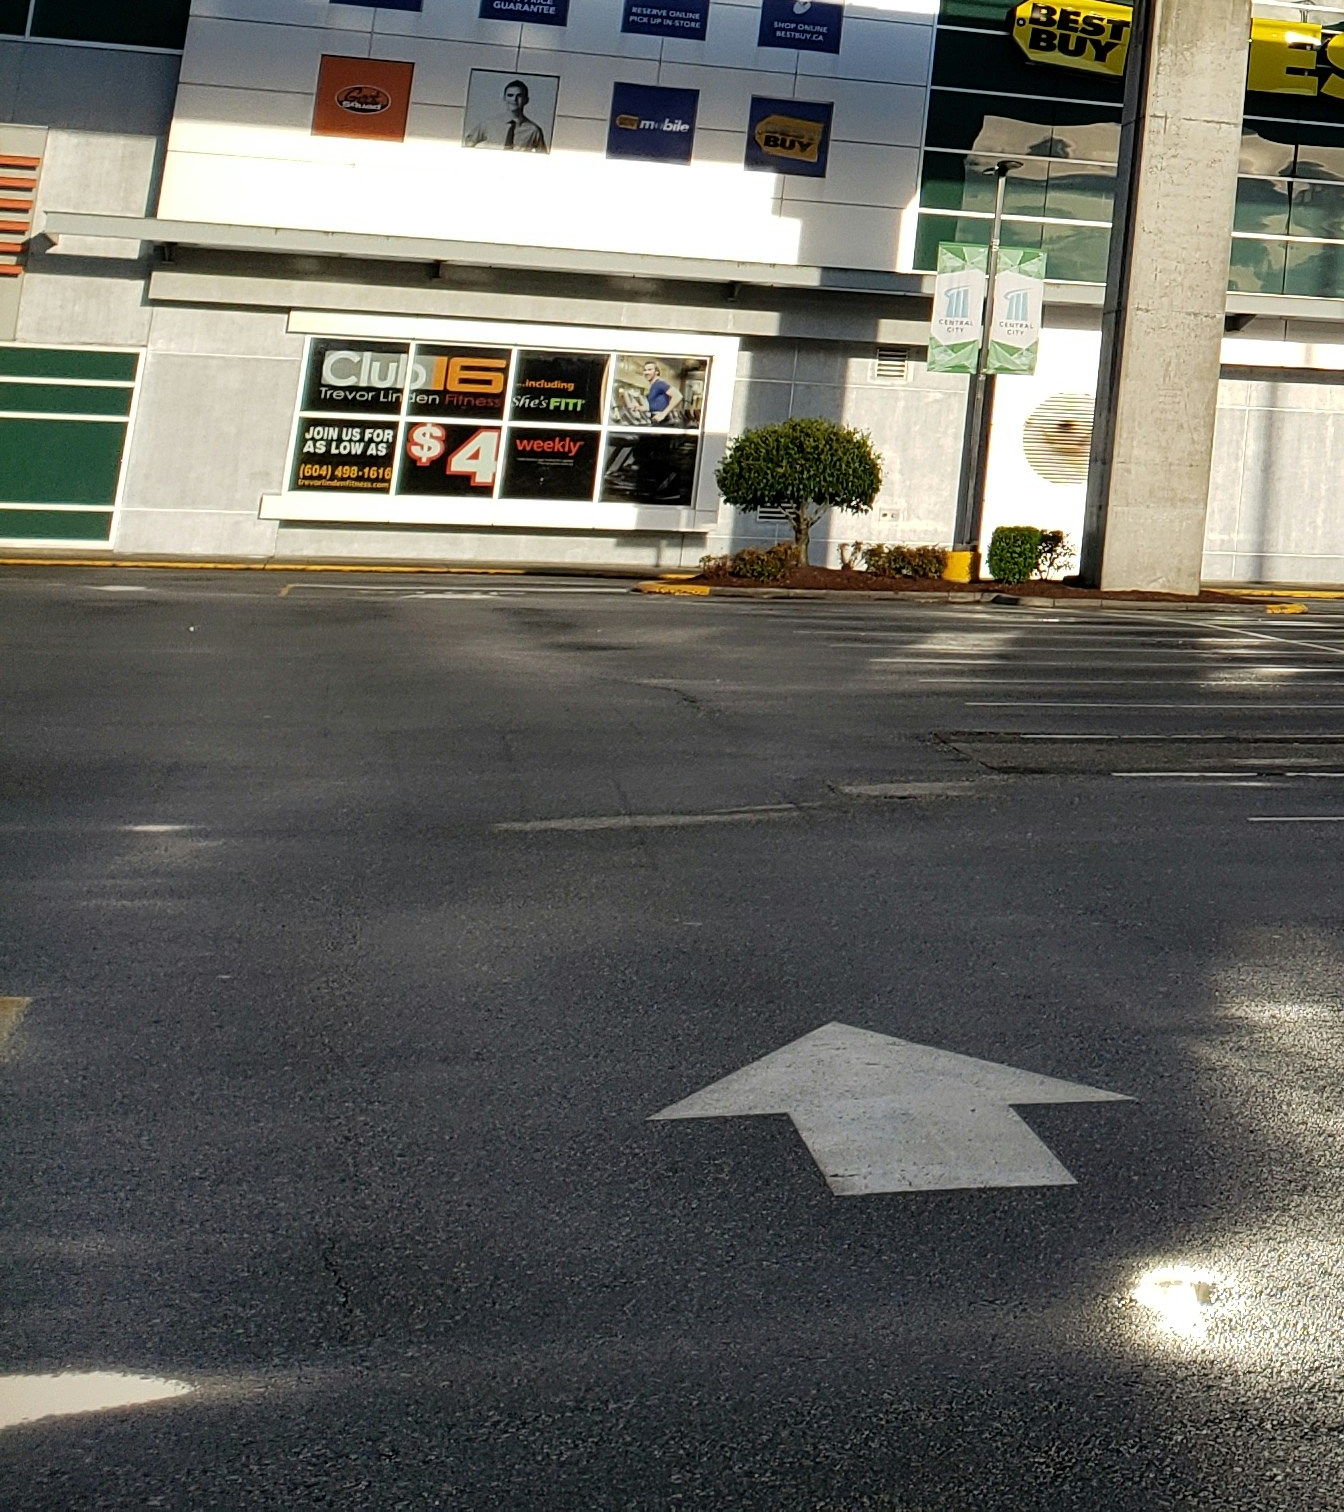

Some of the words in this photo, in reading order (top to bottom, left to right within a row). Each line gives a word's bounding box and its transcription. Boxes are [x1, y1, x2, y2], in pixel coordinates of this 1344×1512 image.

[493, 0, 556, 14] GUARANTEE
[632, 6, 667, 16] RESERVE
[669, 10, 700, 20] ONLINE
[773, 21, 796, 29] SHOP
[797, 23, 828, 33] ONLINE
[1028, 2, 1131, 42] BEST
[1028, 26, 1120, 63] BUY
[763, 134, 815, 153] BUY
[939, 318, 974, 326] CENTRAL
[999, 321, 1034, 329] CENTRAL
[322, 350, 427, 389] Club
[319, 387, 374, 402] Trevor
[379, 390, 439, 405] Linden
[444, 393, 501, 408] Fitness
[512, 395, 548, 408] She's
[304, 426, 339, 440] JOIN
[341, 428, 361, 441] US
[364, 429, 394, 442] FOR
[303, 440, 327, 454] AS
[330, 441, 364, 455] LOW
[366, 443, 387, 456] AS
[300, 464, 332, 479] (604)
[334, 466, 392, 479] 498-1616
